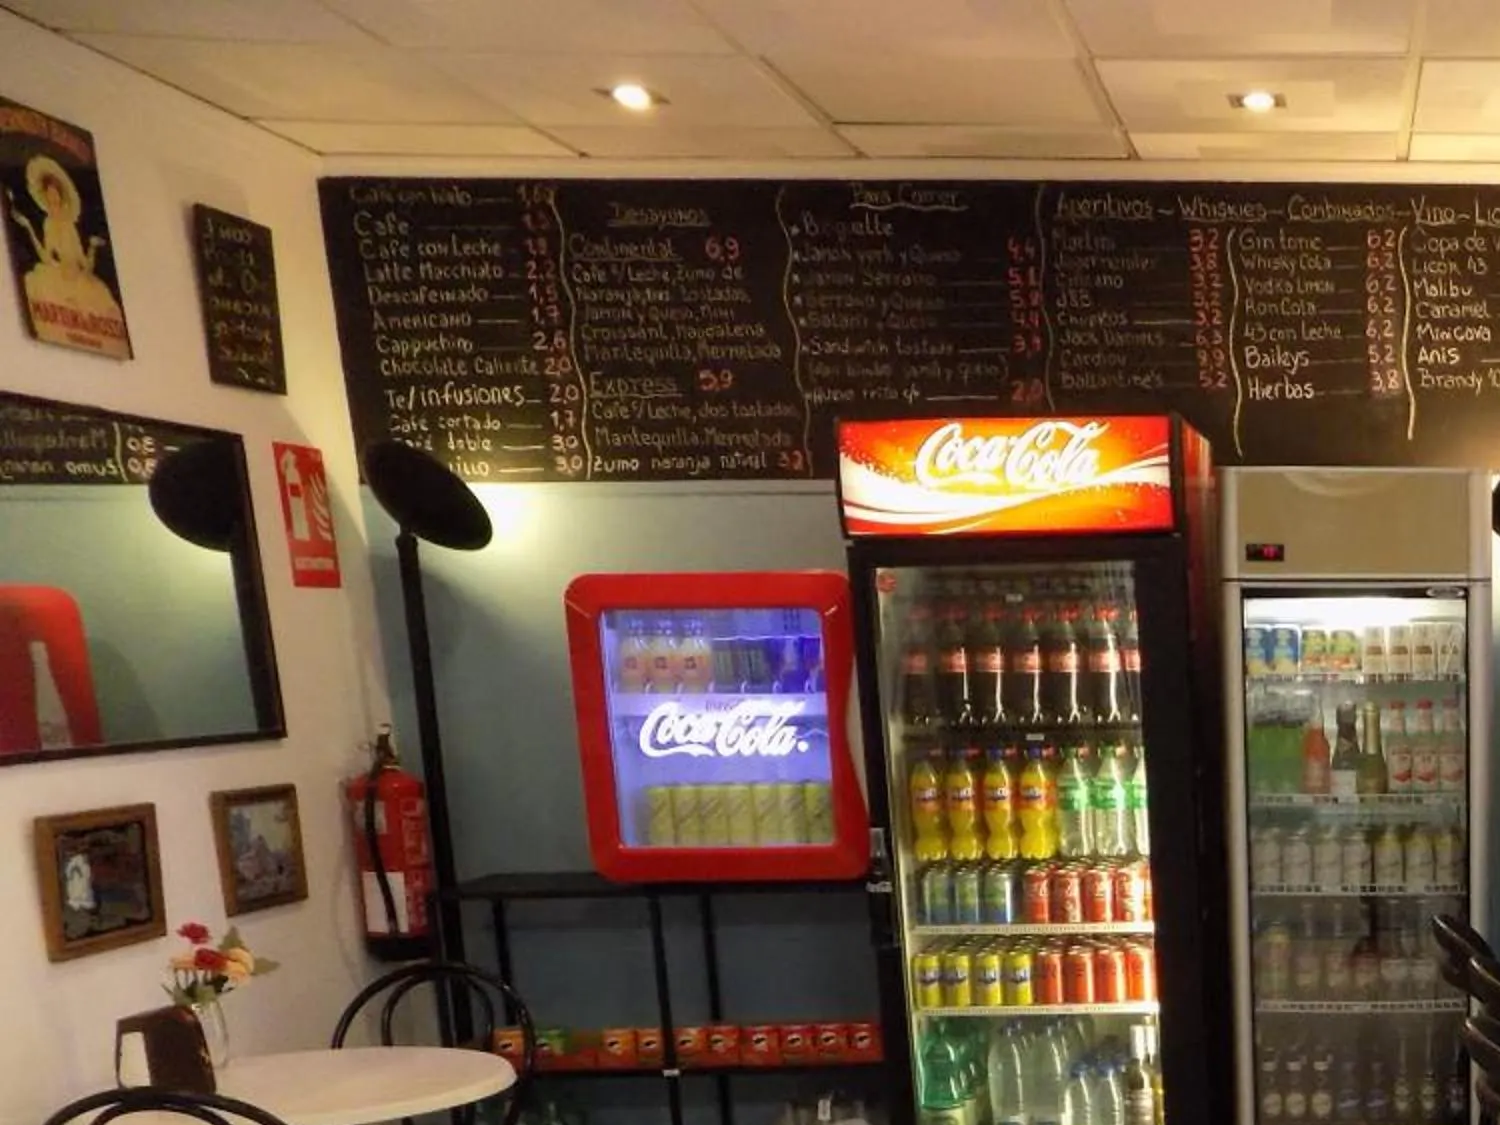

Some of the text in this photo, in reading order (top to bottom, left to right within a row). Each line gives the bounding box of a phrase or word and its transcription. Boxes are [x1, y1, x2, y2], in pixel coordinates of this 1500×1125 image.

[1178, 195, 1267, 220] Whiskies
[1410, 193, 1457, 226] Vino
[1240, 228, 1275, 251] Gin
[1464, 228, 1488, 253] de
[1240, 253, 1296, 278] Whisky
[1413, 278, 1473, 299] Malibu
[1245, 298, 1278, 317] Ron
[1415, 300, 1492, 320] Caramel
[1417, 345, 1461, 366] Anis
[589, 371, 680, 400] Express
[1248, 372, 1315, 400] Hierbas
[1417, 367, 1484, 397] Brandy
[914, 421, 1110, 489] Coca-Cola
[639, 699, 804, 757] Coca-Cola
